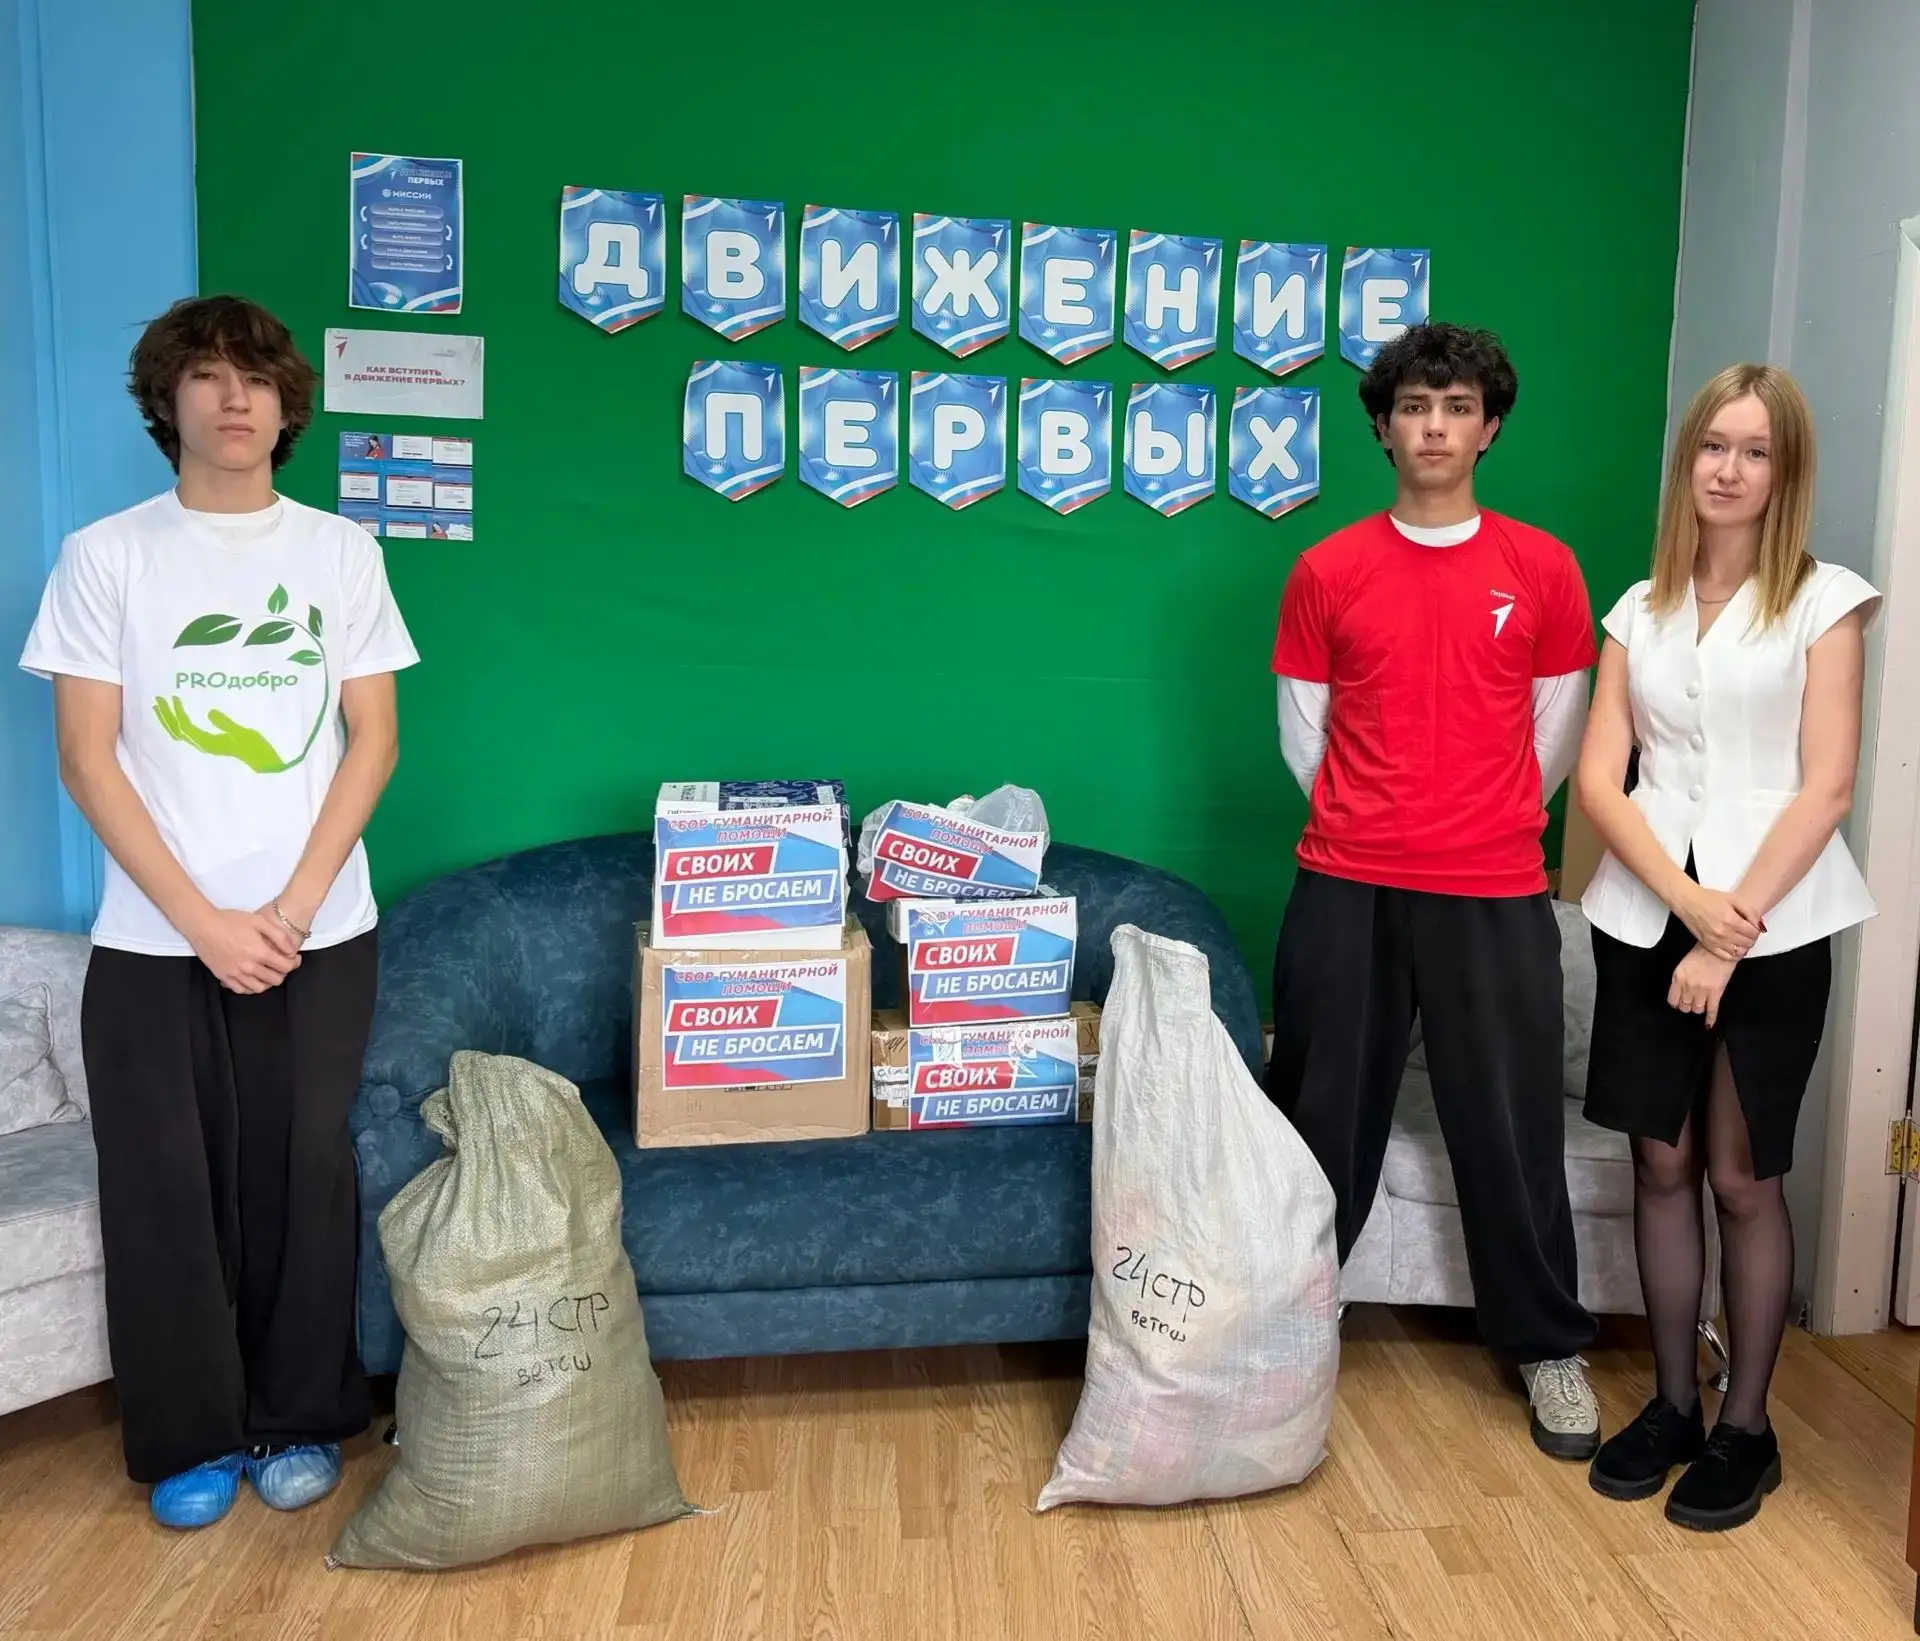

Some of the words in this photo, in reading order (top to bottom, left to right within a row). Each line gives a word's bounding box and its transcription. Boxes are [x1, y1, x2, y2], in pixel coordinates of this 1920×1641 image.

[407, 177, 445, 186] ПЕРВЫХ
[573, 221, 1410, 342] ДВИЖЕНИЕ
[344, 373, 352, 381] В
[353, 374, 413, 384] ДВИЖЕНИЕ
[415, 376, 466, 386] ПЕРВЫХ?
[366, 366, 386, 374] КАК
[388, 367, 442, 376] ВСТУПИТЬ
[704, 392, 1300, 481] ПЕРВЫХ
[175, 671, 298, 692] PROдобро
[668, 819, 708, 832] СБОР
[713, 808, 833, 829] ГУМАНИТАРНОЙ
[931, 815, 1039, 848] ГУМАНИТАРНОЙ
[717, 827, 787, 844] ПОМОЩИ
[931, 829, 994, 856] ПОМОЩИ
[676, 852, 755, 876] СВОИХ
[887, 840, 961, 873] СВОИХ
[688, 885, 717, 905] НЕ
[722, 879, 821, 902] БРОСАЕМ
[894, 868, 919, 889] НЕ
[922, 876, 1016, 898] БРОСАЕМ
[960, 901, 1069, 918] ГУМАНИТАРНОЙ
[963, 919, 1027, 934] ПОМОЩИ
[924, 943, 998, 966] СВОИХ
[674, 971, 714, 984] СБОР
[718, 963, 838, 983] ГУМАНИТАРНОЙ
[936, 974, 960, 994] НЕ
[966, 968, 1057, 992] БРОСАЕМ
[721, 981, 793, 996] ПОМОЩИ
[680, 1005, 760, 1027] СВОИХ
[691, 1038, 719, 1057] НЕ
[724, 1032, 824, 1055] БРОСАЕМ
[925, 1065, 998, 1088] СВОИХ
[935, 1098, 961, 1117] НЕ
[966, 1092, 1058, 1114] БРОСАЕМ
